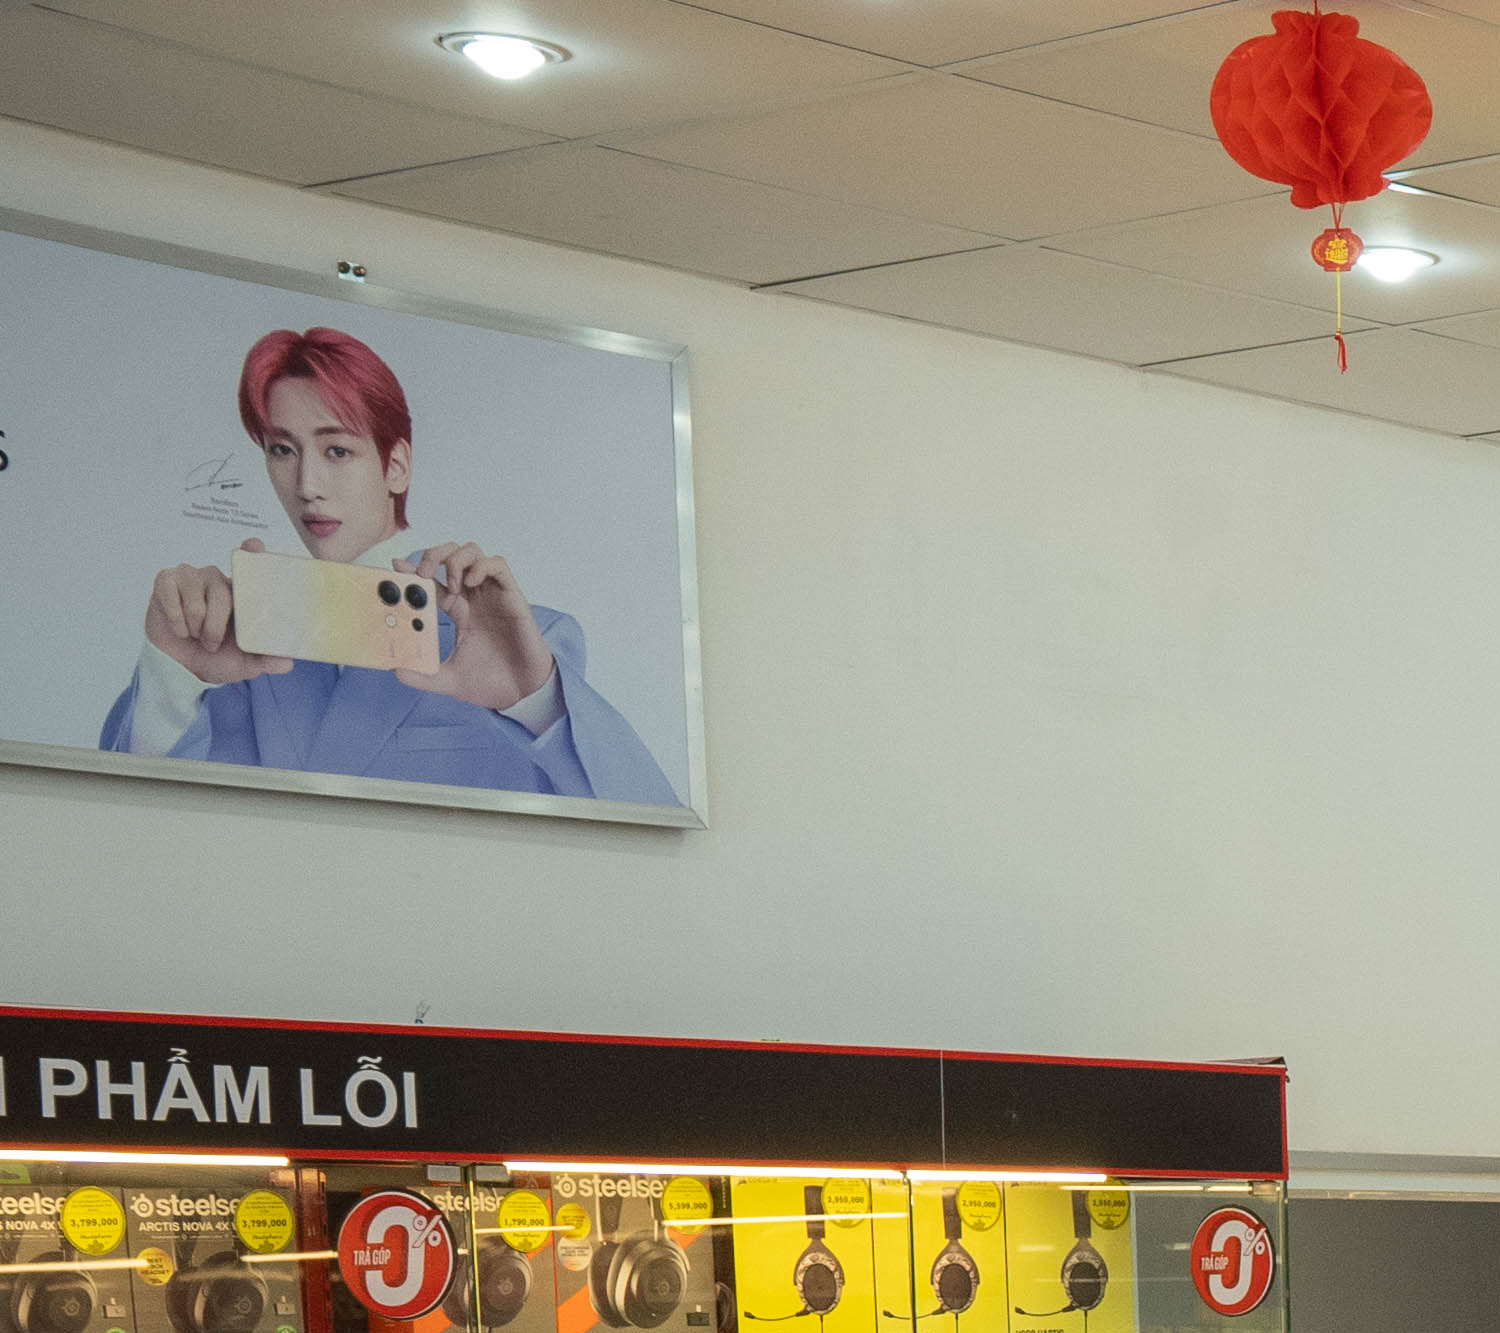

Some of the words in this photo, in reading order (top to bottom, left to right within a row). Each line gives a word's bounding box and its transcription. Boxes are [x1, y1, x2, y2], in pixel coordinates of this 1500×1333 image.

[39, 1048, 272, 1125] PHẨM
[302, 1055, 419, 1129] LỖI
[70, 1217, 118, 1227] 3,799,000
[354, 1249, 371, 1266] TRẢ
[373, 1248, 391, 1265] GÓP
